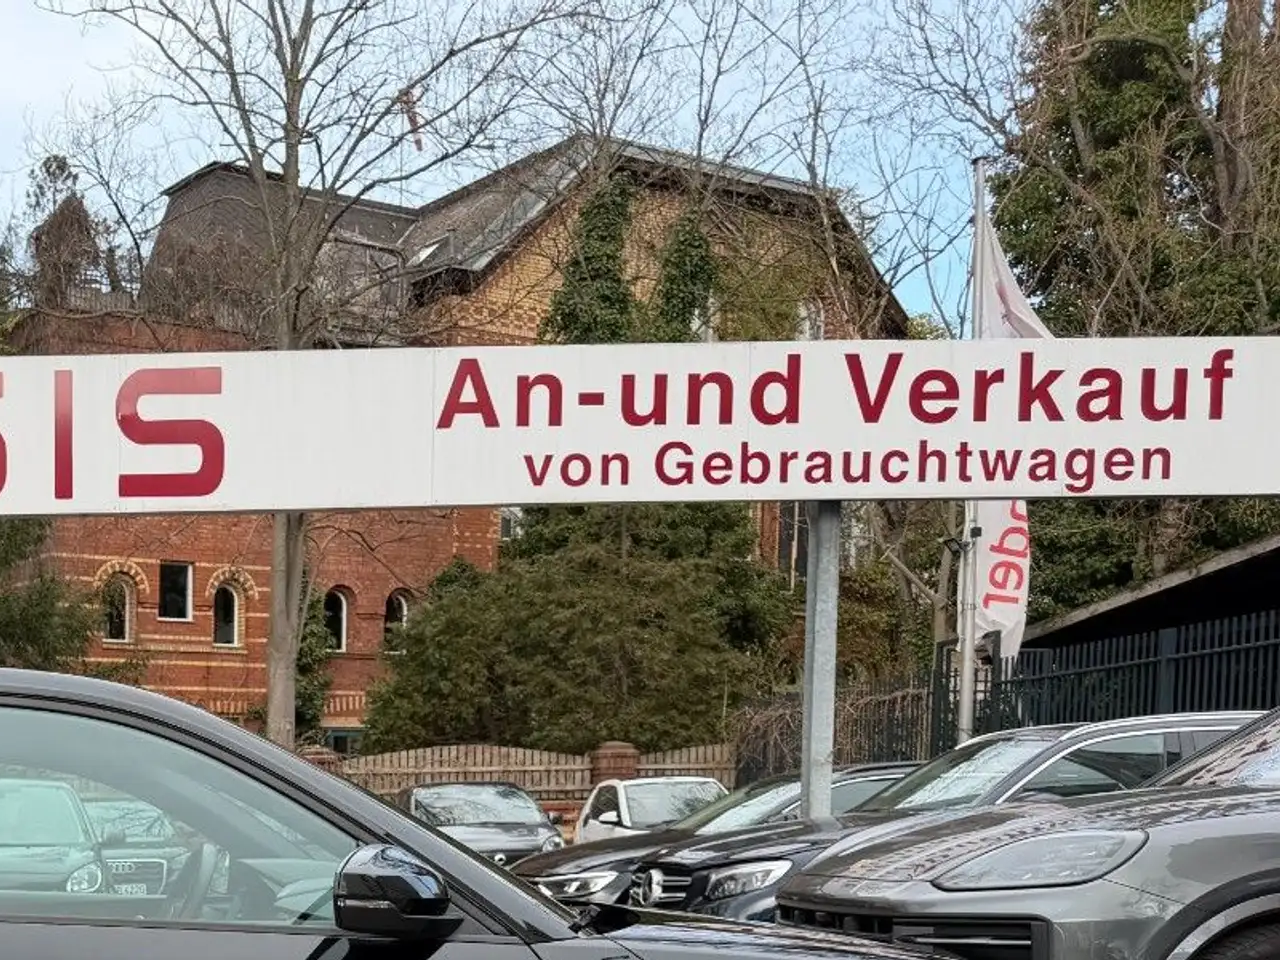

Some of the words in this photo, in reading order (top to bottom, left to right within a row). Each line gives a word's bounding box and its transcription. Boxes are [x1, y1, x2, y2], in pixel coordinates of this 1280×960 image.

[844, 348, 1234, 424] Verkauf
[524, 452, 630, 487] von
[655, 440, 1172, 494] Gebrauchtwagen
